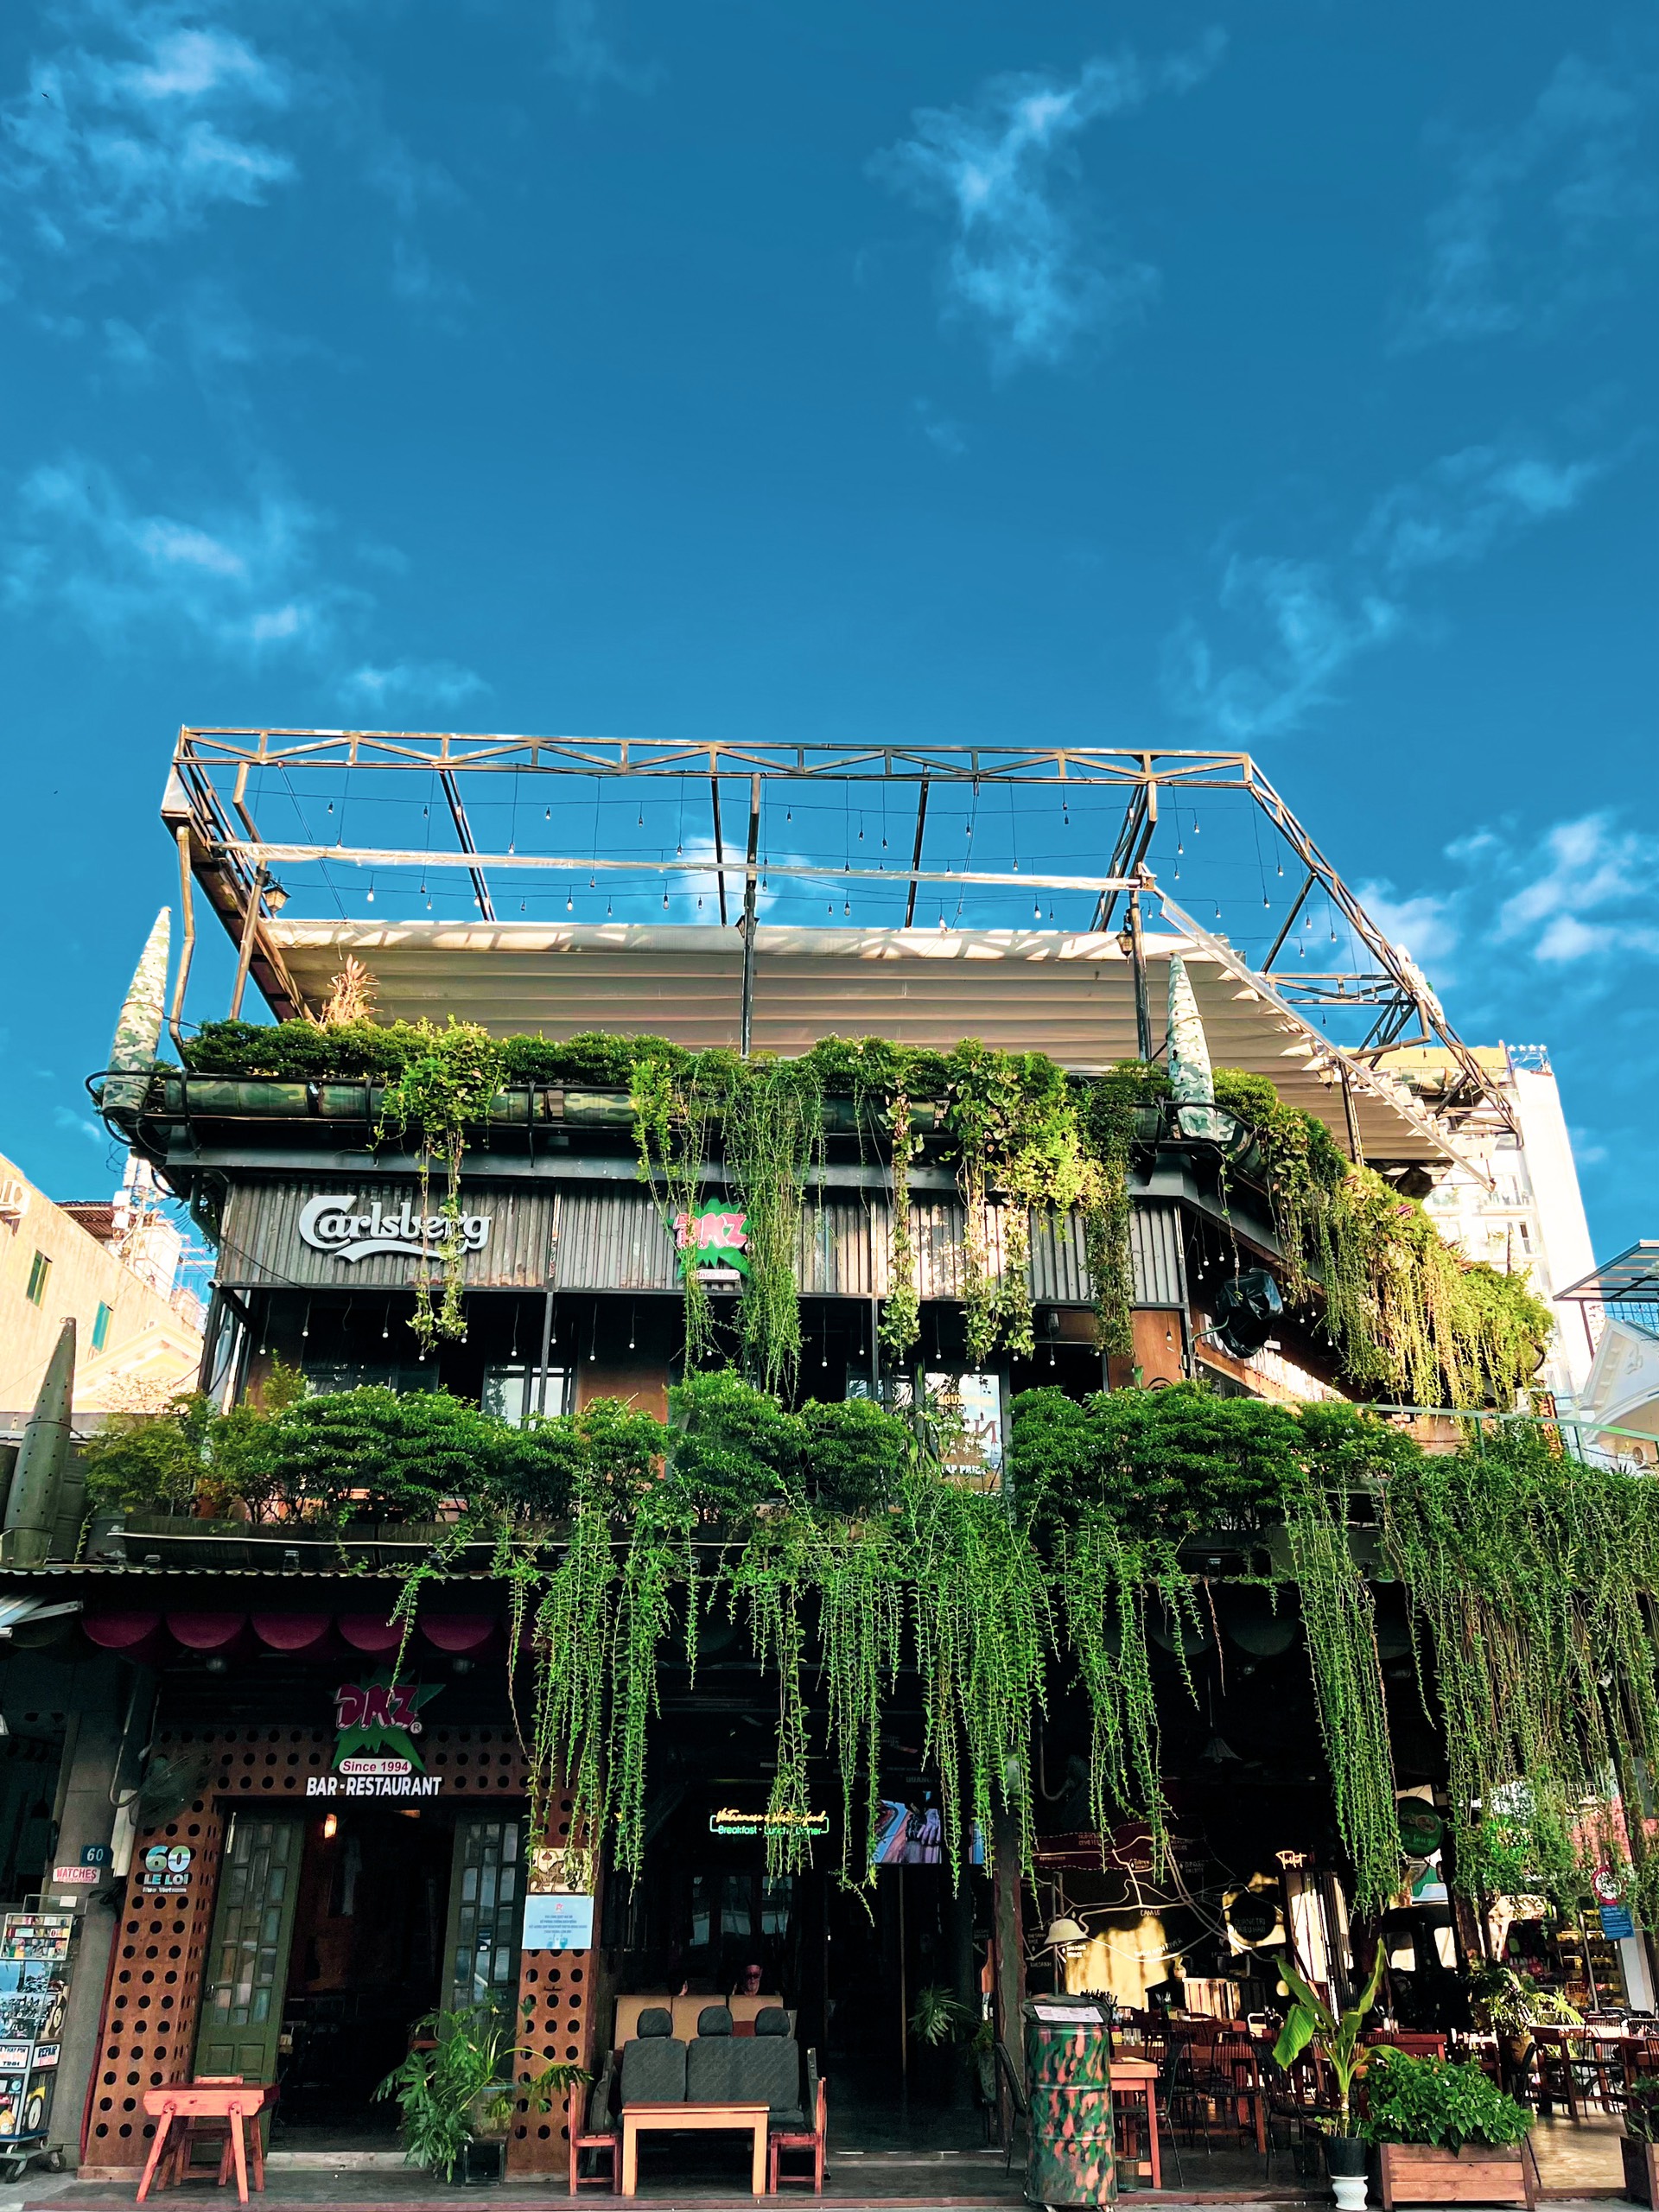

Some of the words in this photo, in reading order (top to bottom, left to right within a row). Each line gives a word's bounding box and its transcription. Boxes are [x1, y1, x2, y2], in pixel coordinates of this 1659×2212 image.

[334, 1683, 419, 1731] DMZ
[342, 1761, 377, 1771] Since
[381, 1762, 409, 1771] 1994
[717, 1825, 758, 1834] Breakfast
[87, 1847, 104, 1861] 60
[145, 1845, 191, 1872] 60
[56, 1868, 98, 1879] WATCHES
[143, 1874, 162, 1885] LE
[164, 1874, 189, 1885] LOI
